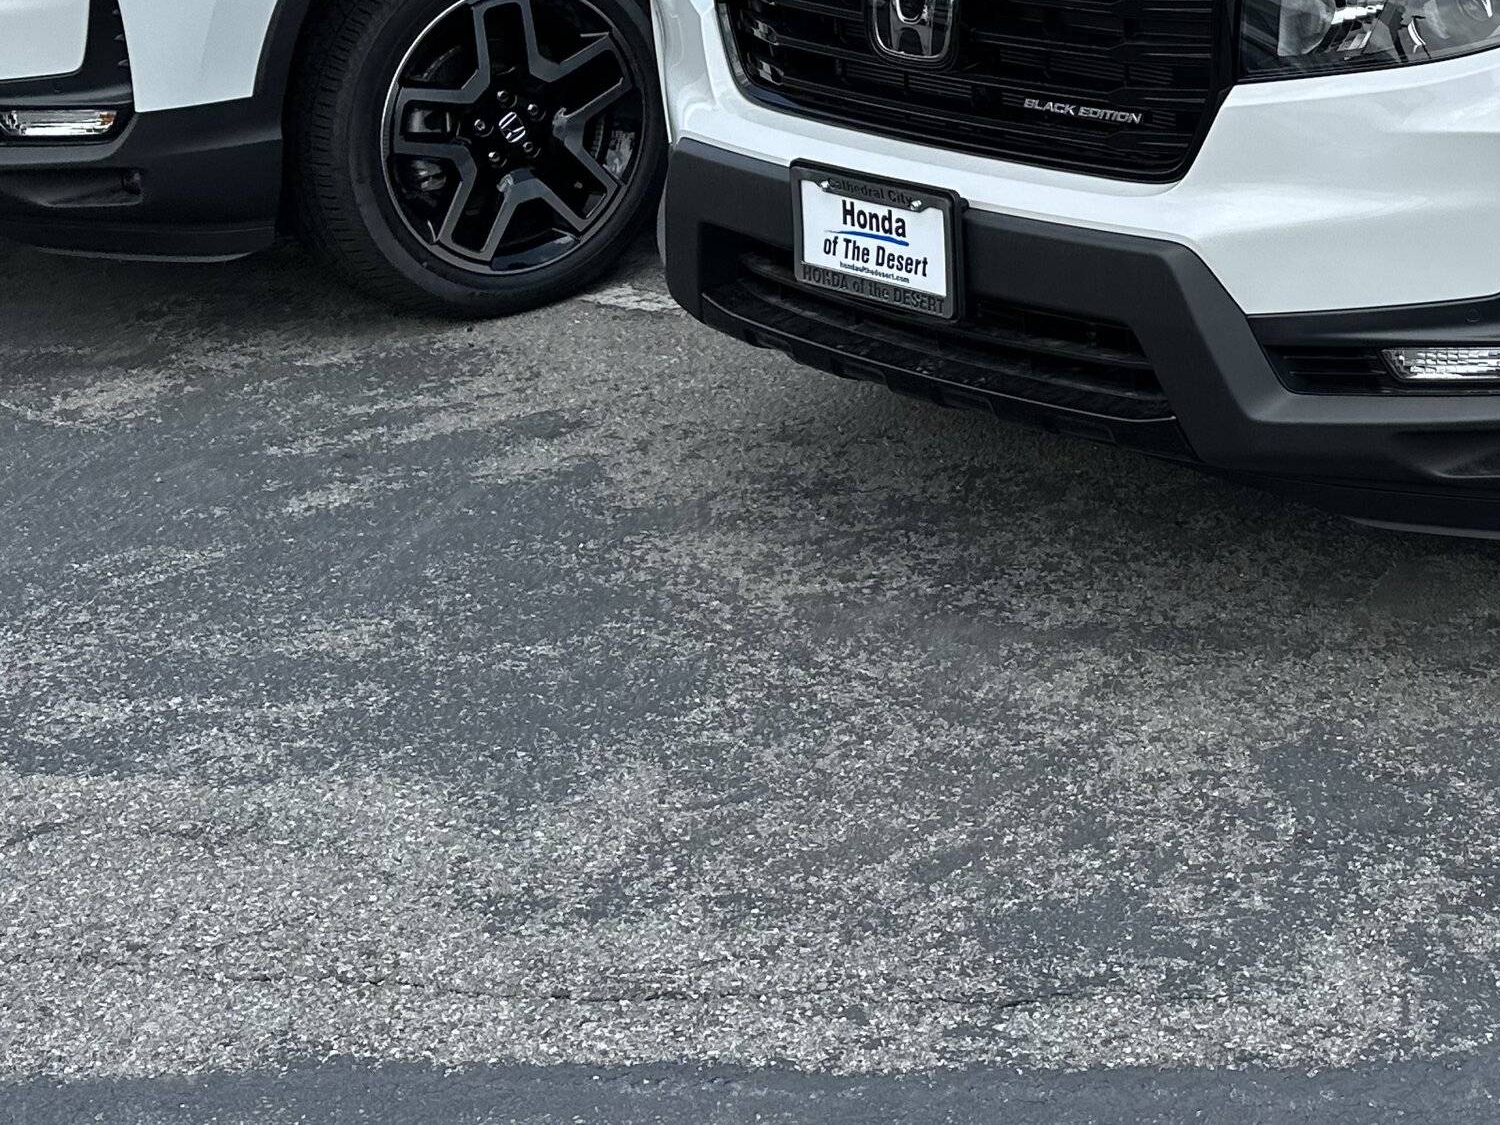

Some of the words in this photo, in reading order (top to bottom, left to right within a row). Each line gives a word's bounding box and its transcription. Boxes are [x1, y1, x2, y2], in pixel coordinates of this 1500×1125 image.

[1023, 98, 1076, 116] BLACK
[1078, 106, 1142, 124] EDITION
[888, 190, 913, 207] City
[841, 199, 907, 238] Honda
[823, 236, 839, 257] of
[843, 238, 870, 264] The
[875, 245, 928, 277] Desert
[802, 265, 848, 290] HONDA
[852, 276, 865, 293] of
[868, 281, 889, 300] the
[893, 287, 945, 314] DESERT
